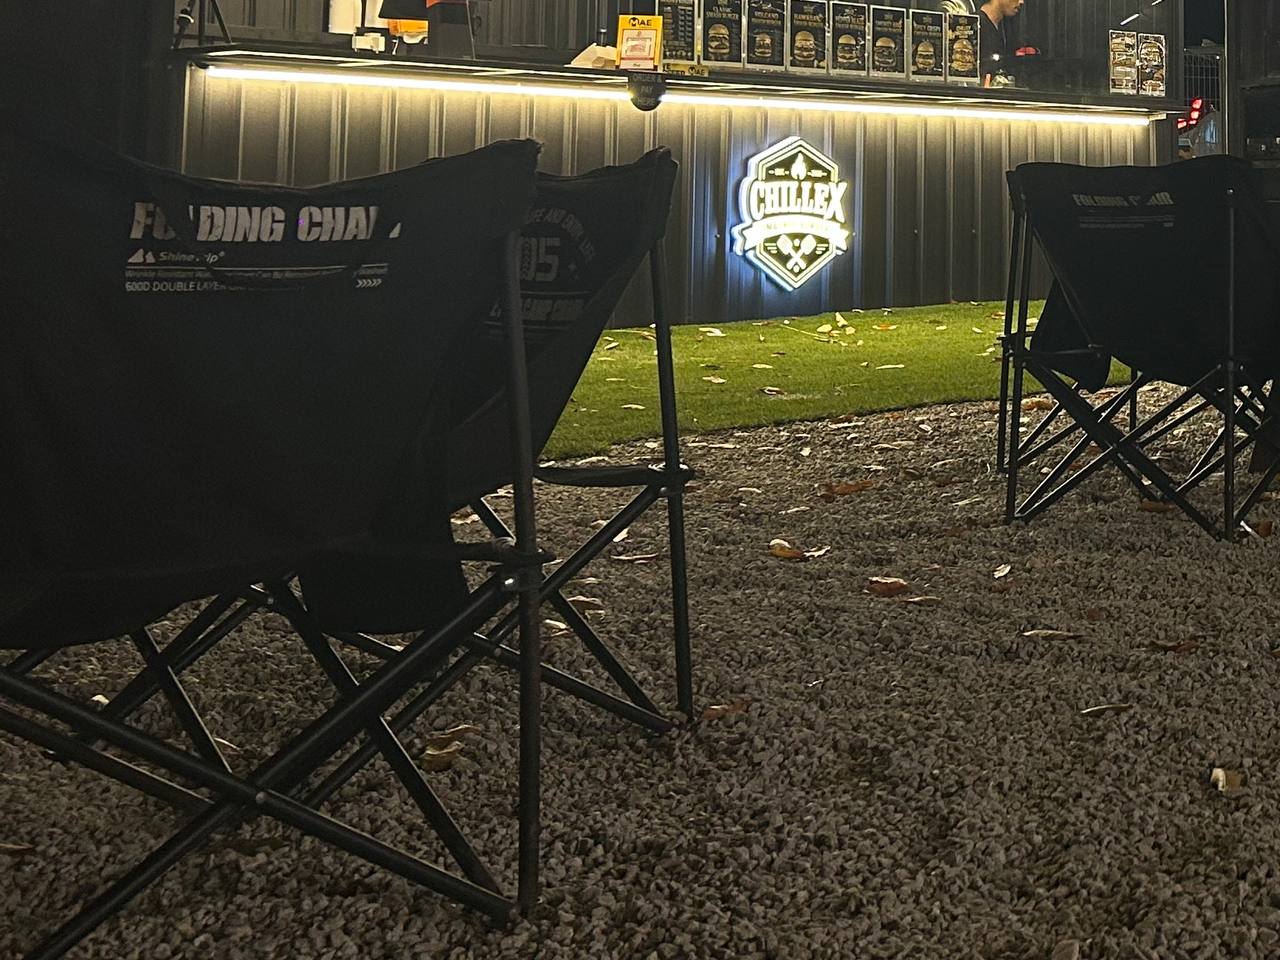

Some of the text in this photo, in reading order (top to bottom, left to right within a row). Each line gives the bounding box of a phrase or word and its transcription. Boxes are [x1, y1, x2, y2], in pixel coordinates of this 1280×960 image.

[629, 17, 652, 27] MAE
[750, 180, 848, 224] CHILLEX
[153, 281, 196, 292] DOUBLE
